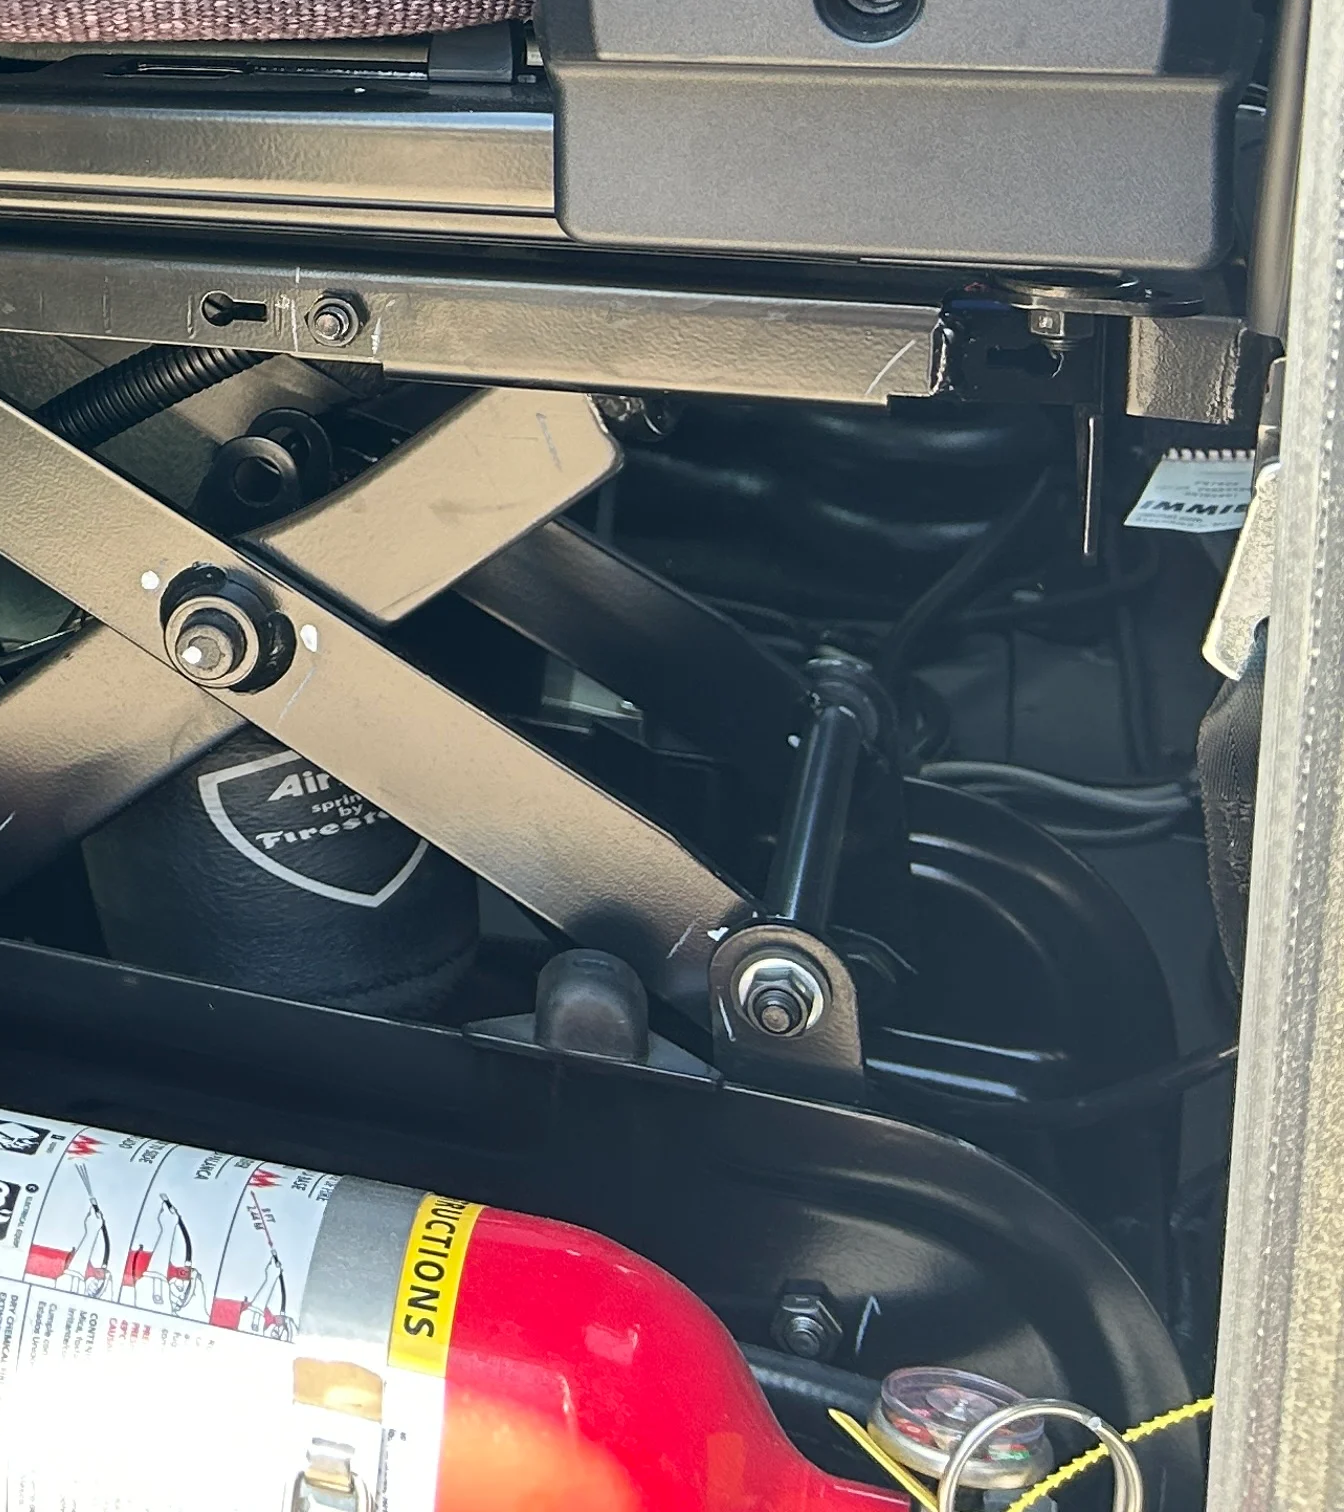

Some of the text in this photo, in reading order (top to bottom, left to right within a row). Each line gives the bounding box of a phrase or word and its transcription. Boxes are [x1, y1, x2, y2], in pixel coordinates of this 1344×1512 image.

[311, 793, 363, 814] sprin
[338, 804, 363, 817] by
[255, 810, 391, 850] Firest
[403, 1199, 465, 1338] RUCTIONS
